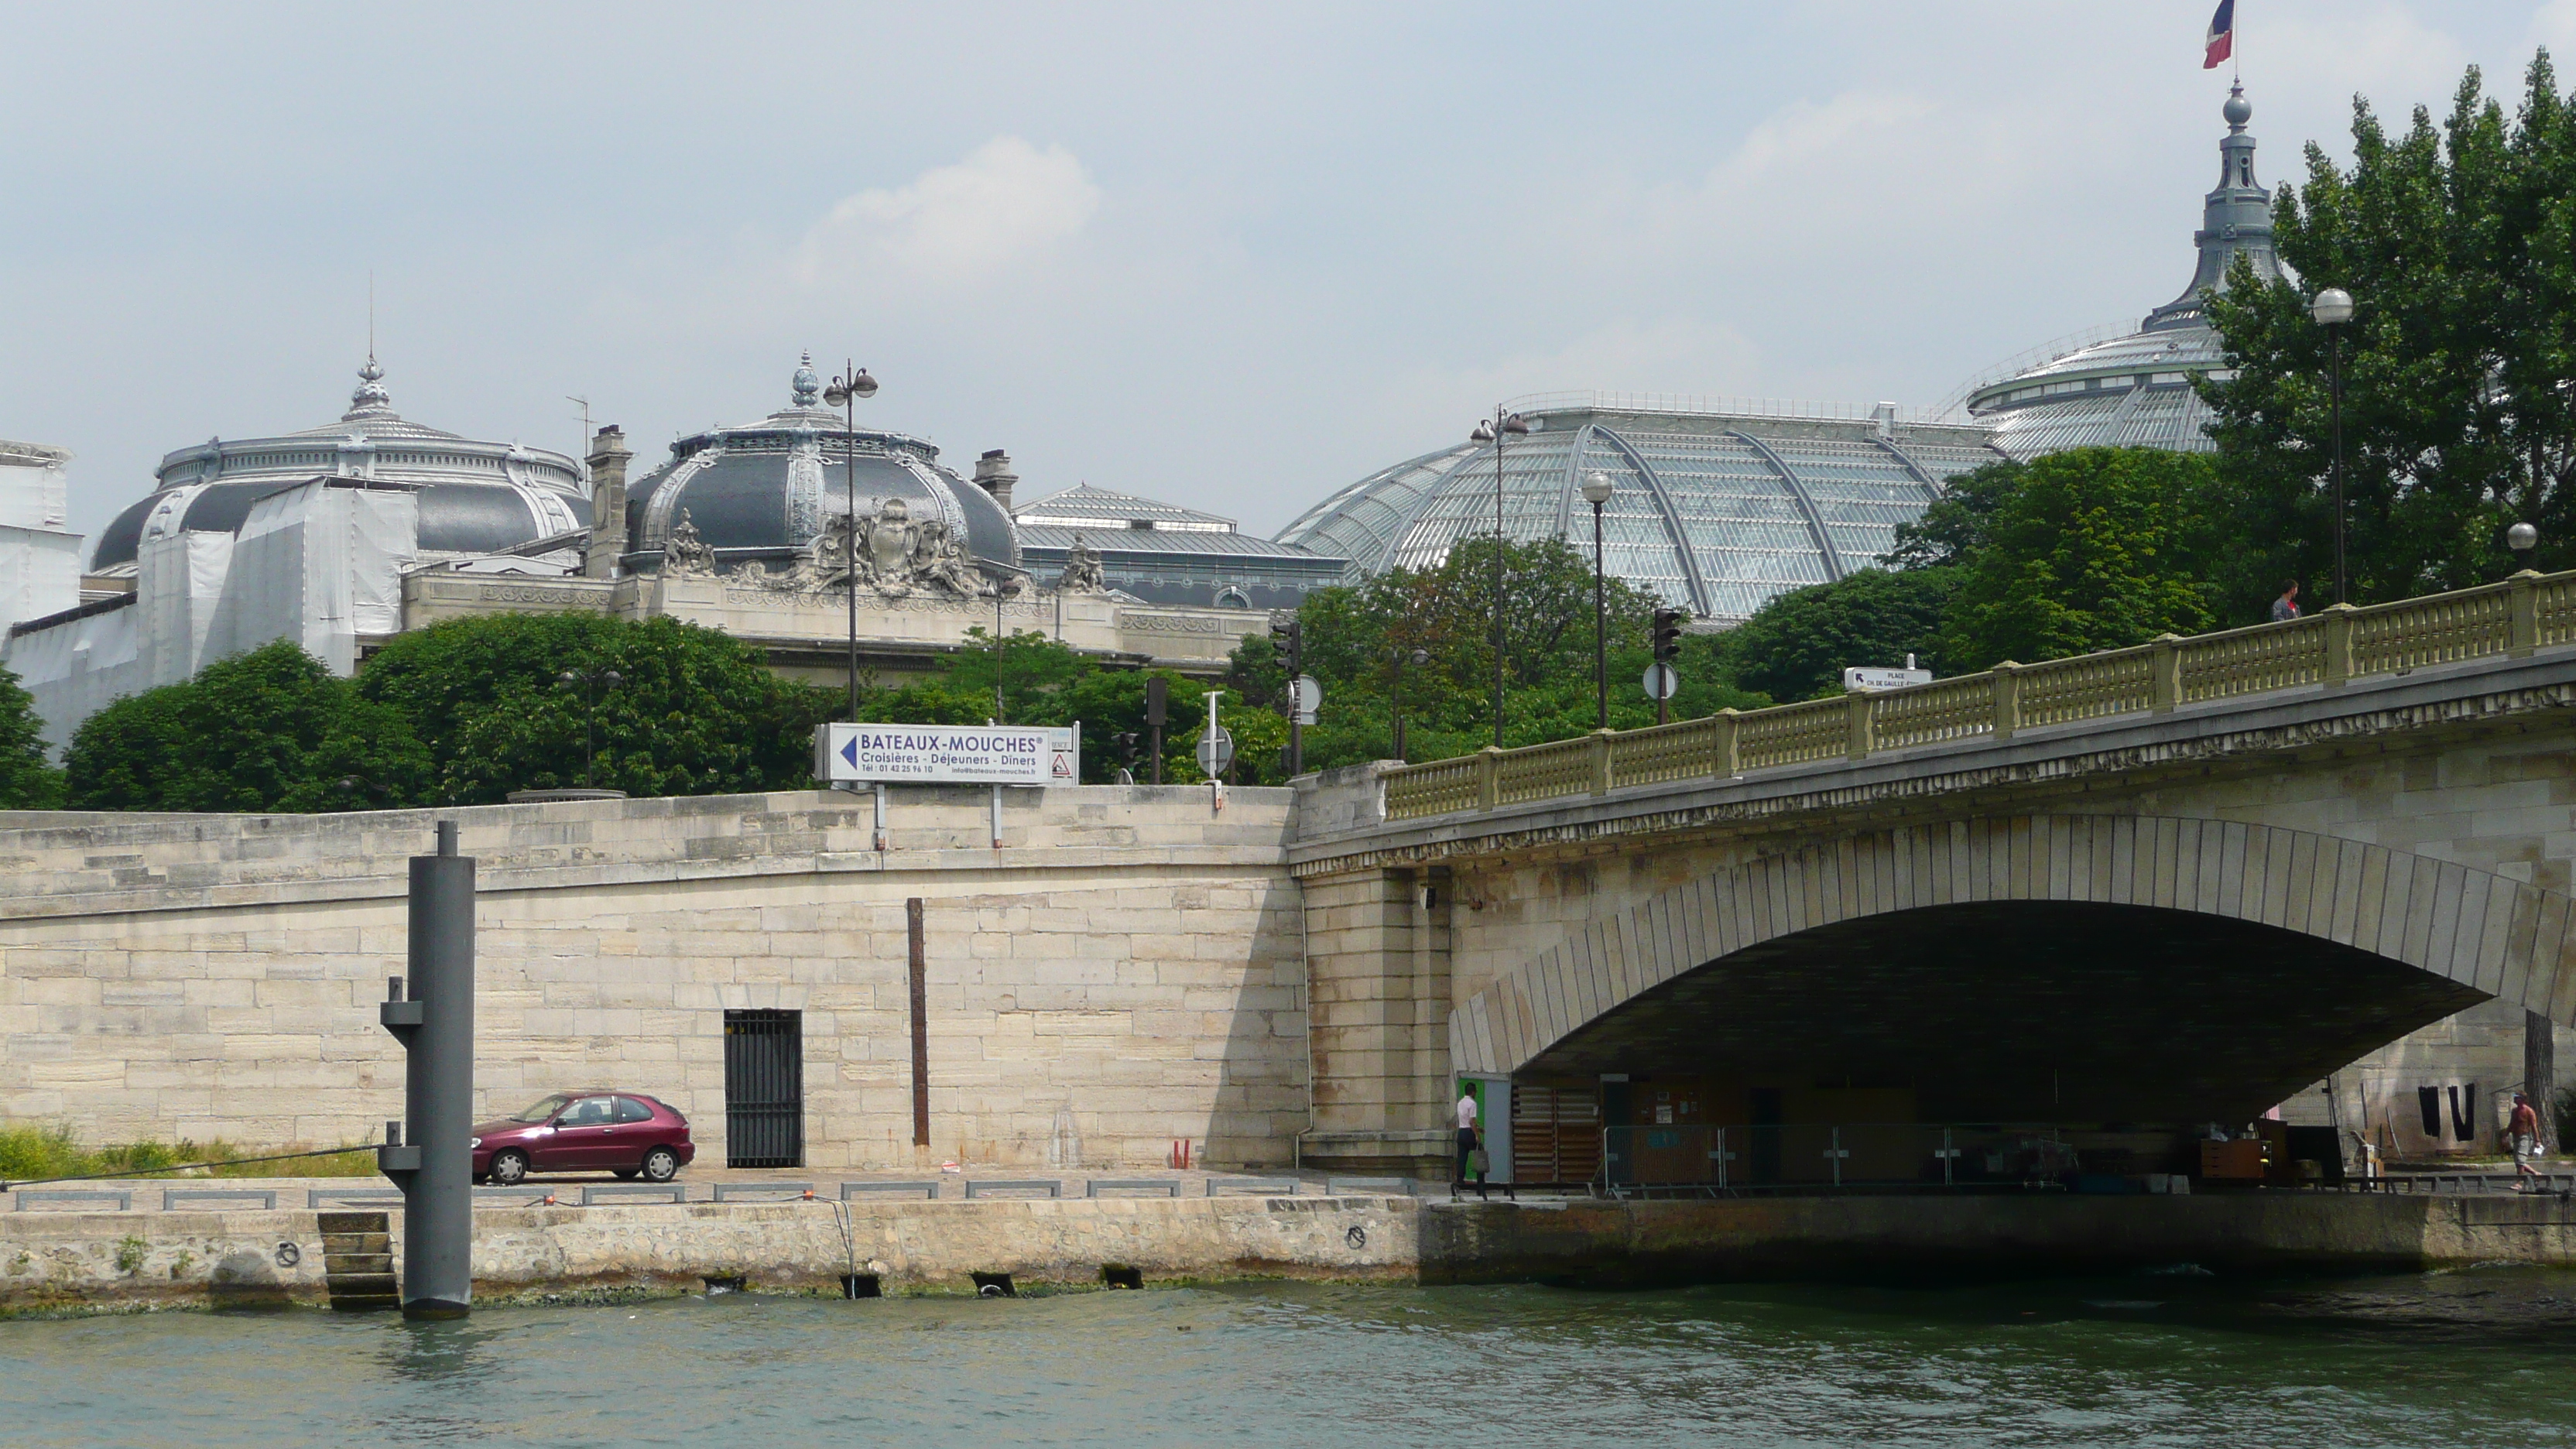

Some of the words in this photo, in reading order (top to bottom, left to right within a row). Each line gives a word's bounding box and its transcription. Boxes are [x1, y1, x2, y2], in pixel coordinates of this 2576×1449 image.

[862, 752, 919, 763] Croisières
[931, 752, 989, 766] Déjeuners
[1002, 754, 1036, 766] Dîners
[951, 766, 1036, 775] info@bateaux-mouches.fr
